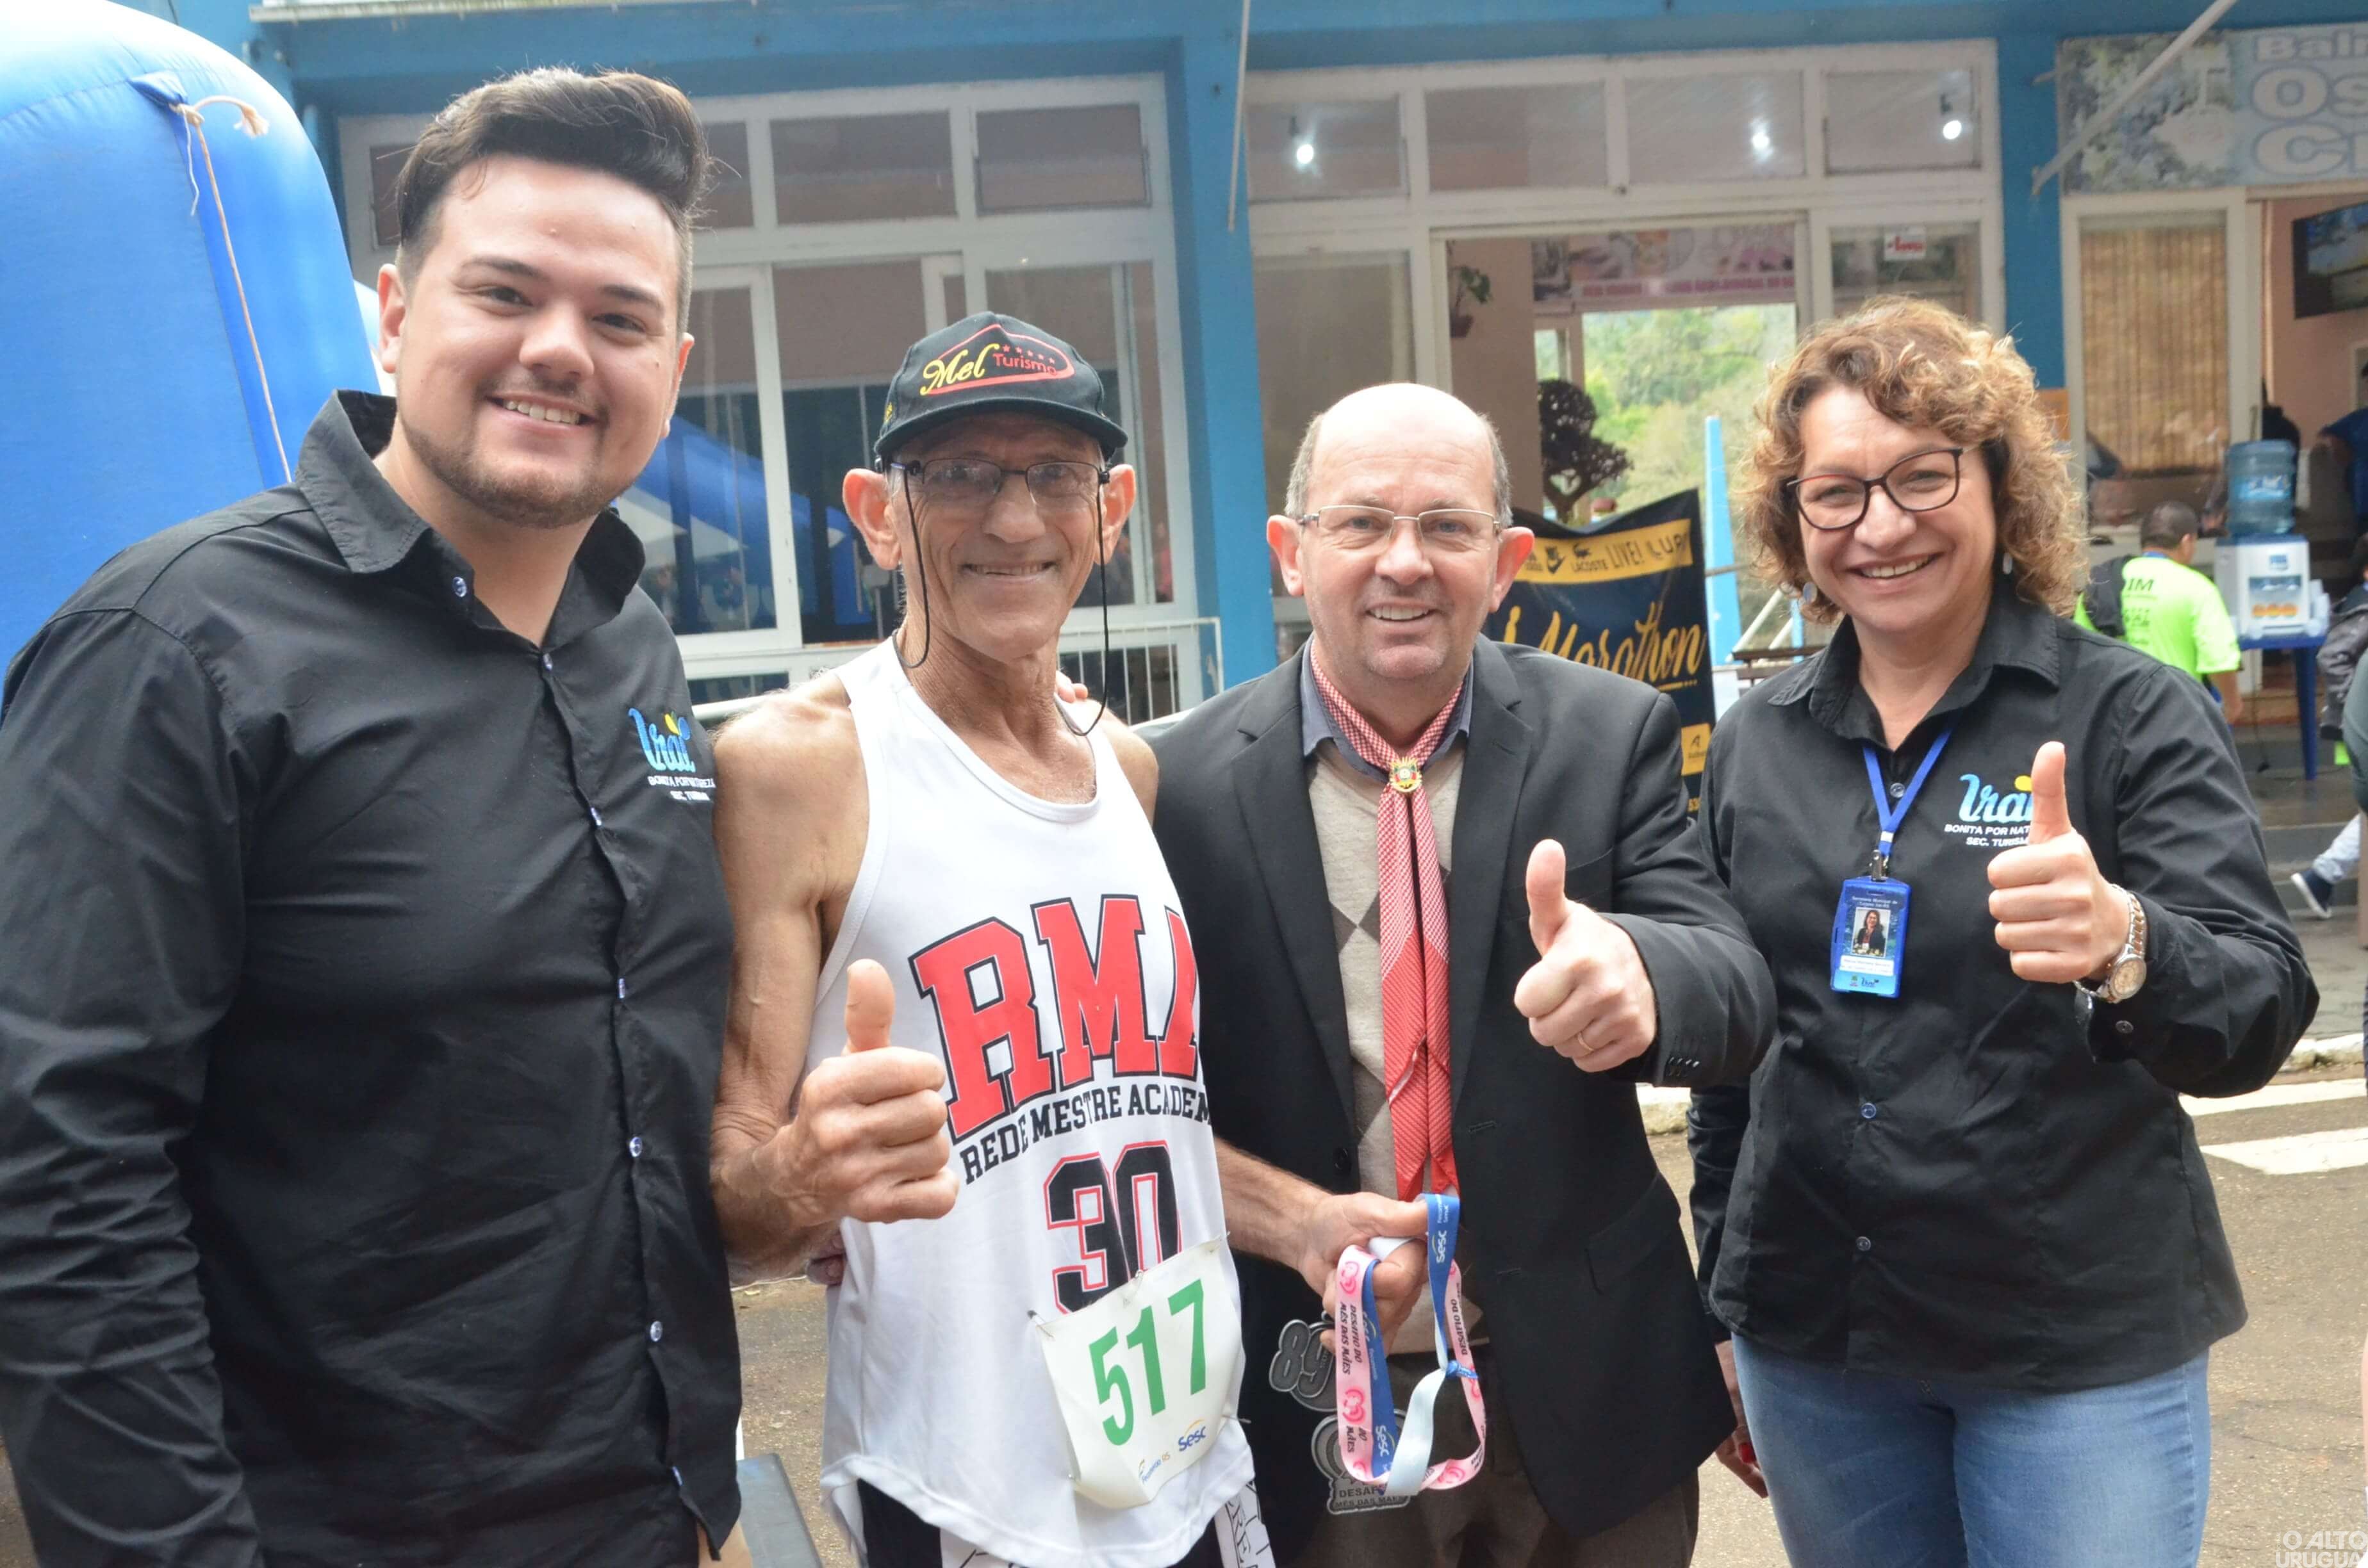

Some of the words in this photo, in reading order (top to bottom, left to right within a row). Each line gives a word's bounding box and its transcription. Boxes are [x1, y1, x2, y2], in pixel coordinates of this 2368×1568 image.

[920, 343, 999, 396] Mel
[993, 353, 1057, 376] Turismo
[1944, 824, 1982, 834] BONITA
[1985, 825, 2007, 836] POR
[2009, 826, 2030, 836] NAT
[1966, 837, 1989, 846] SEC.
[1992, 837, 2030, 847] TURISM
[959, 1115, 1029, 1185] REDE
[1032, 1083, 1122, 1143] MESTRE
[1128, 1084, 1212, 1125] ACADEM
[1043, 1139, 1181, 1315] 30
[1089, 1278, 1206, 1446] 517
